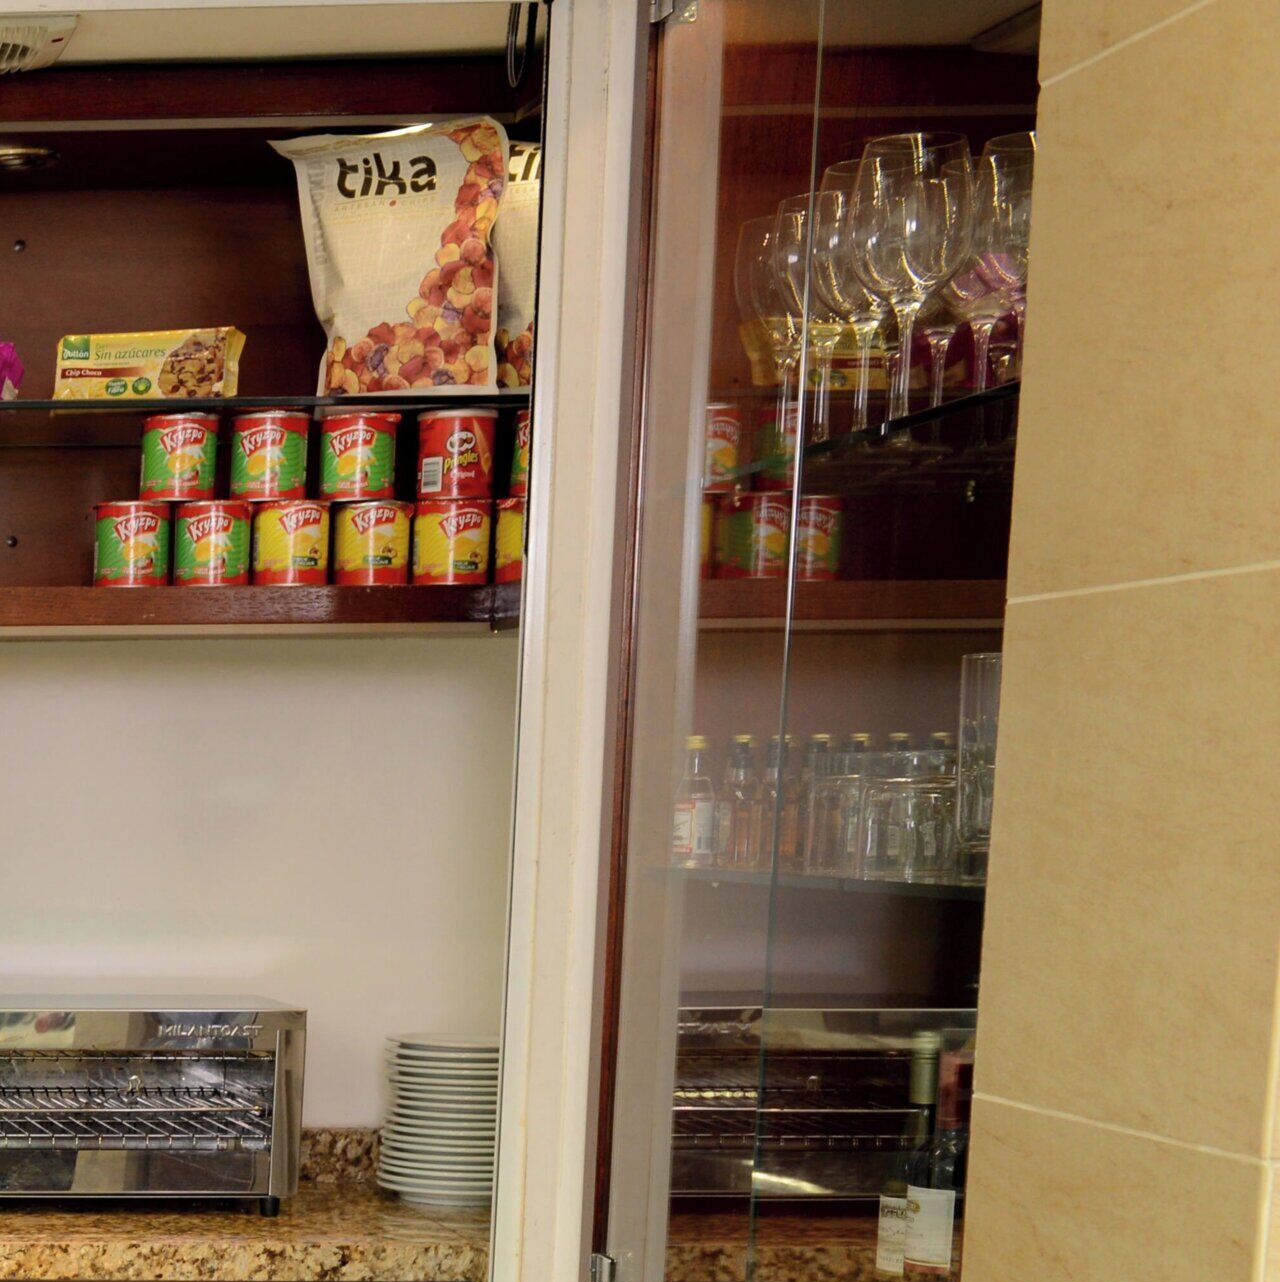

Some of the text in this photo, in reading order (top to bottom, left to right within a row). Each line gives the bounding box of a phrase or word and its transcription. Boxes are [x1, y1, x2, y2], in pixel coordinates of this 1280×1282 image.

[337, 152, 437, 198] tika
[94, 347, 166, 361] Sin azúcares
[165, 429, 204, 452] Kryzpo
[243, 431, 282, 453] Kryzpo
[117, 519, 156, 541] Kryzpo
[283, 510, 321, 533] Kryzpo
[354, 507, 395, 532] Kryzpo
[443, 513, 482, 537] Kryzpo
[158, 1025, 263, 1037] MILANTOAST
